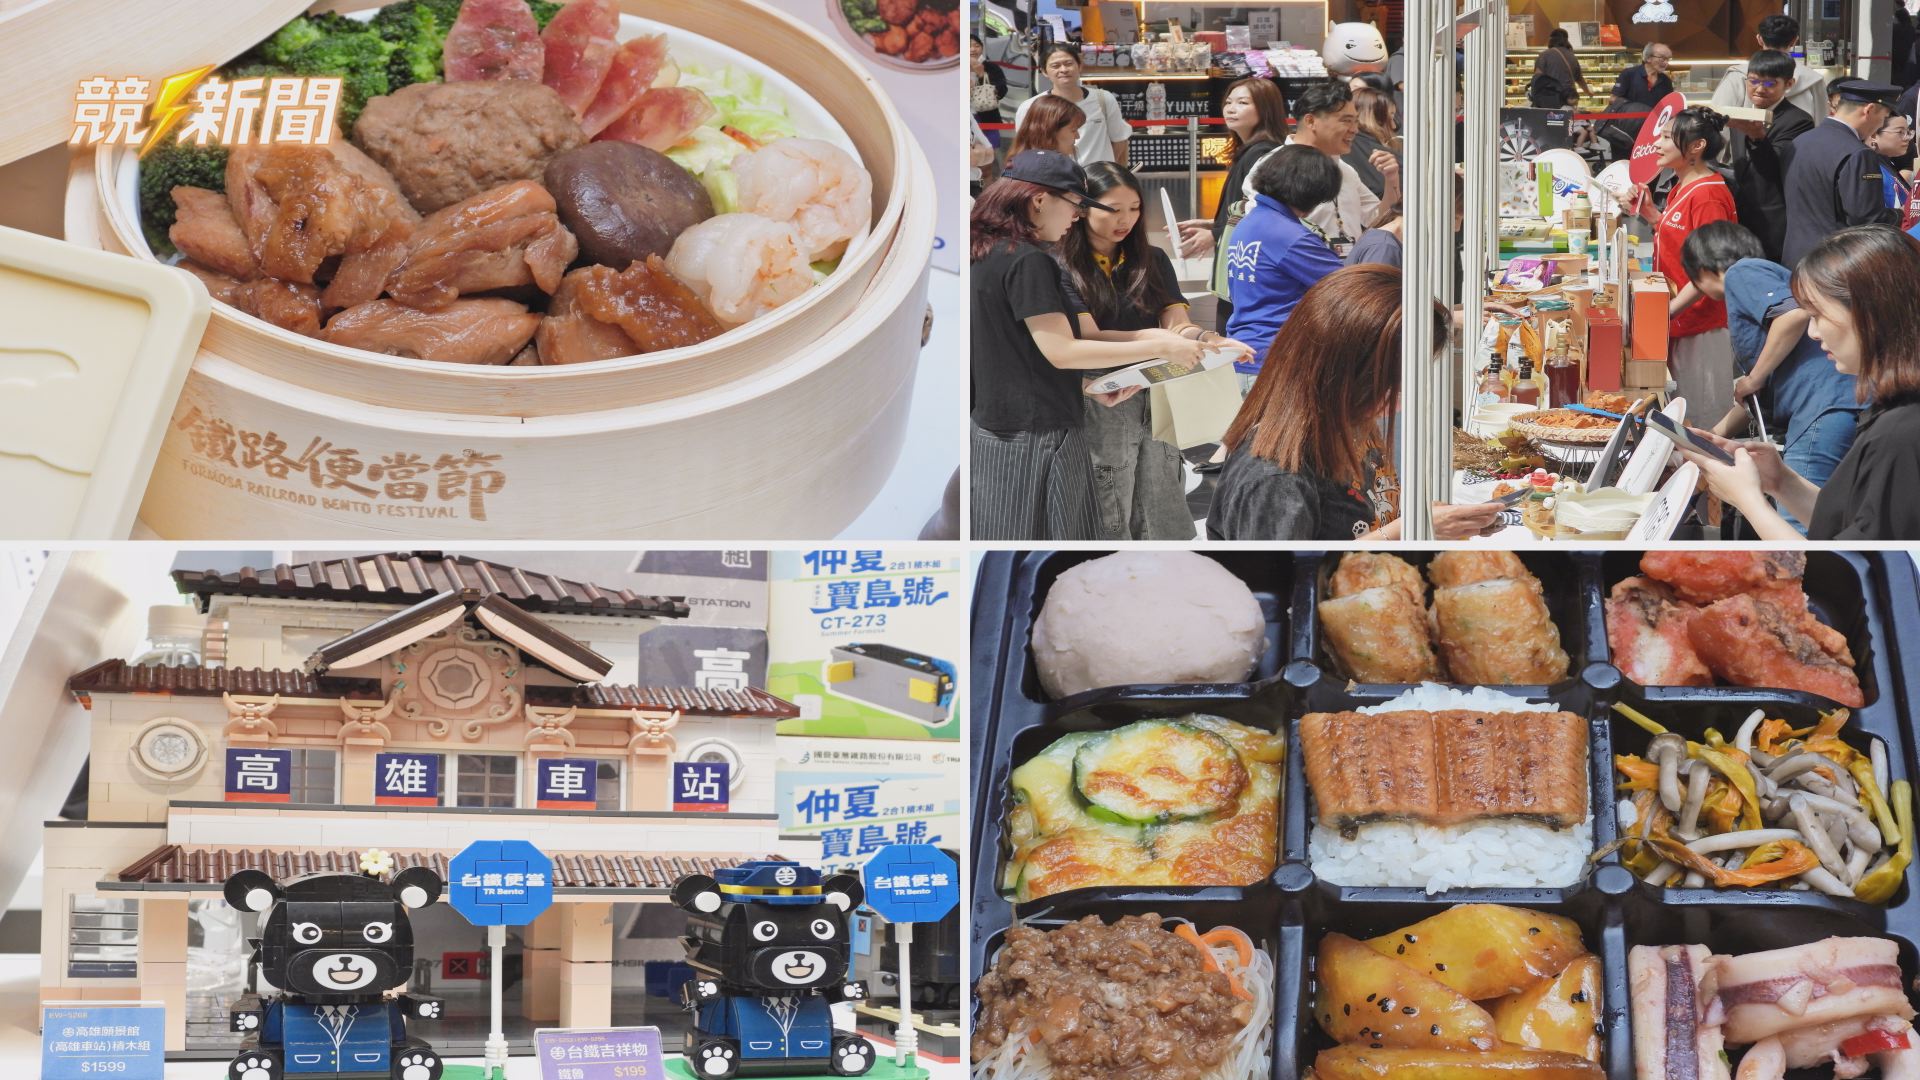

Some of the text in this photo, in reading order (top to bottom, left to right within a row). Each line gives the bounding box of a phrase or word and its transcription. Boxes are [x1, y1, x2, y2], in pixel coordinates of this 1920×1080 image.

[1166, 100, 1209, 113] YUNYE
[173, 404, 506, 521] 鐵路便當節
[182, 459, 459, 519] FORMOSA RAILROAD BENTO FESTIVAL
[803, 550, 887, 575] 仲夏
[688, 597, 751, 609] STATION
[810, 577, 949, 614] 寶島號
[820, 614, 886, 630] CT-273
[235, 754, 721, 801] 高 雄 車 站
[796, 785, 880, 824] 仲夏
[461, 872, 545, 887] 台鐵便當
[874, 873, 949, 889] 台鐵便當
[906, 888, 932, 896] Bento
[567, 1043, 648, 1059] 台鐵吉祥物
[81, 1061, 126, 1073] $1599
[614, 1065, 647, 1078] $199
